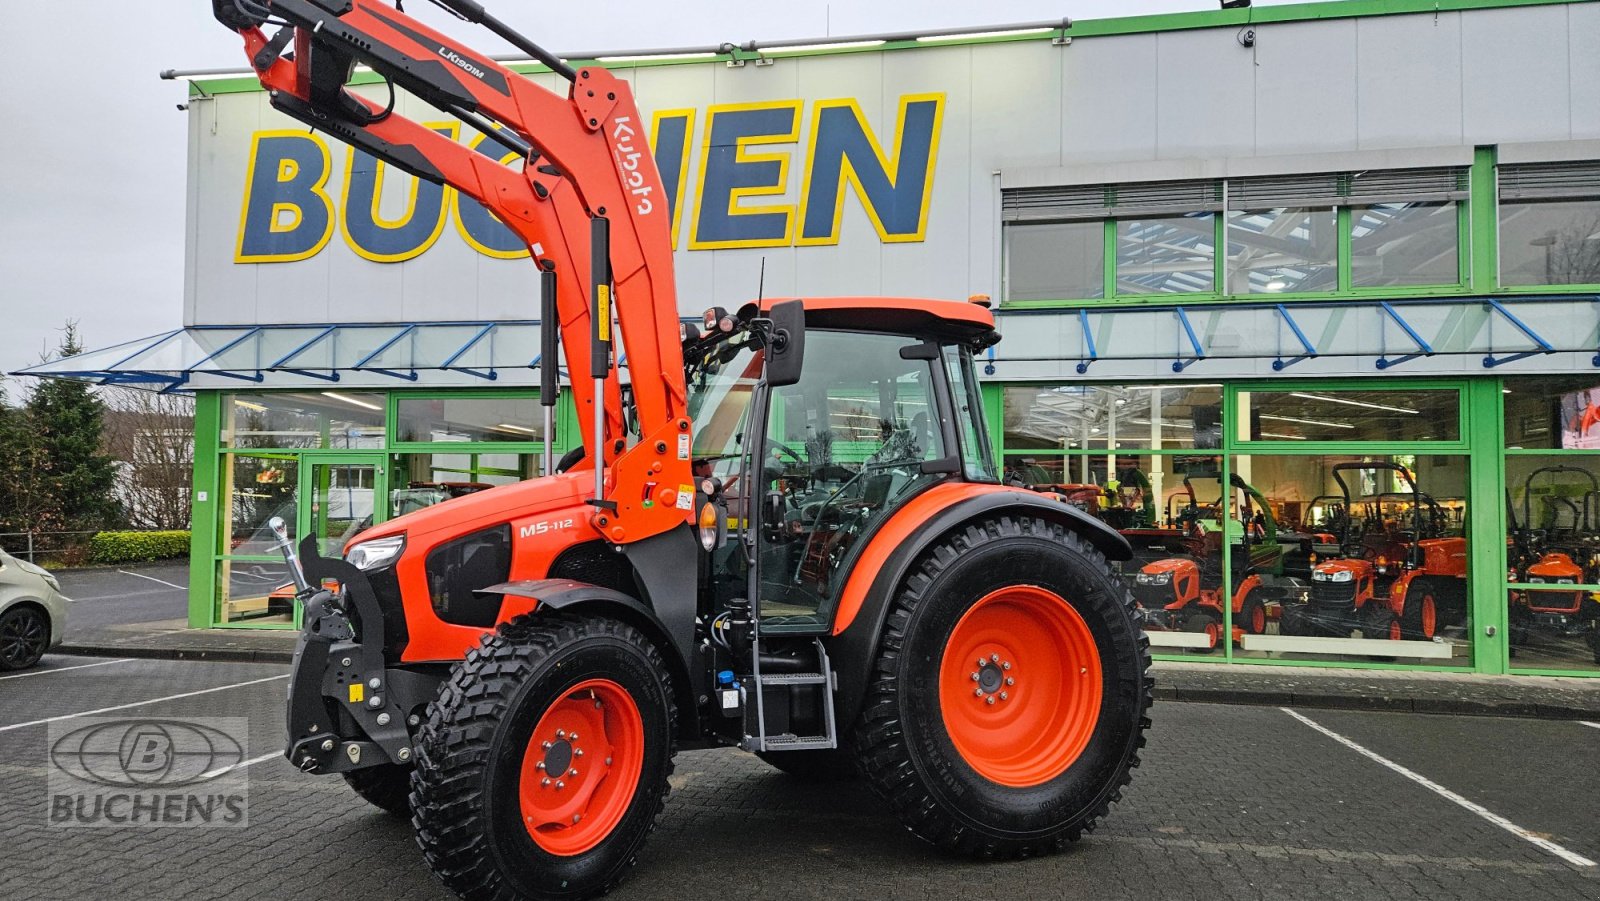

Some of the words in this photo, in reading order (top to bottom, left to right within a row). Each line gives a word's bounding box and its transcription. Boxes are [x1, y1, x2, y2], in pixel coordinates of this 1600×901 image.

[438, 46, 484, 79] LK1901M
[613, 116, 653, 215] Kubota
[520, 519, 573, 538] M5-112
